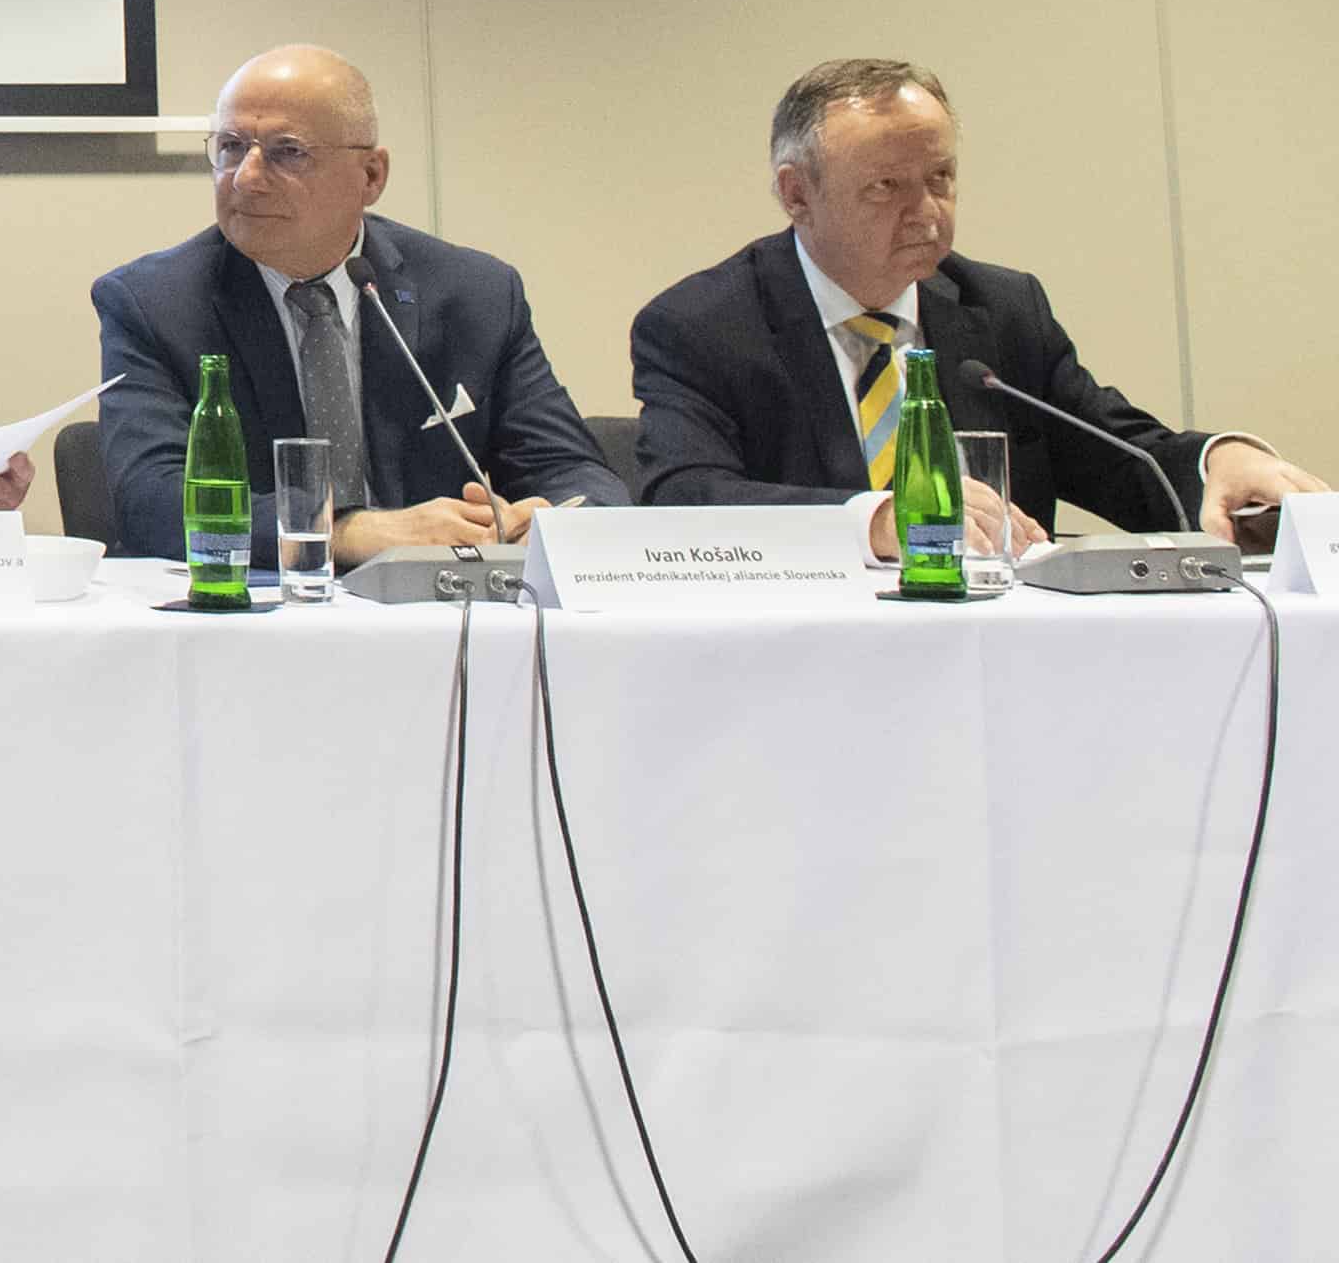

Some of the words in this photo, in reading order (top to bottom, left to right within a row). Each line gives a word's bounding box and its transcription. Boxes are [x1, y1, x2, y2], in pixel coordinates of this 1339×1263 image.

[644, 547, 686, 562] Ivan
[689, 546, 763, 562] Košalko
[574, 570, 634, 583] prezident
[734, 570, 781, 580] aliancie
[783, 569, 847, 580] Slovenska
